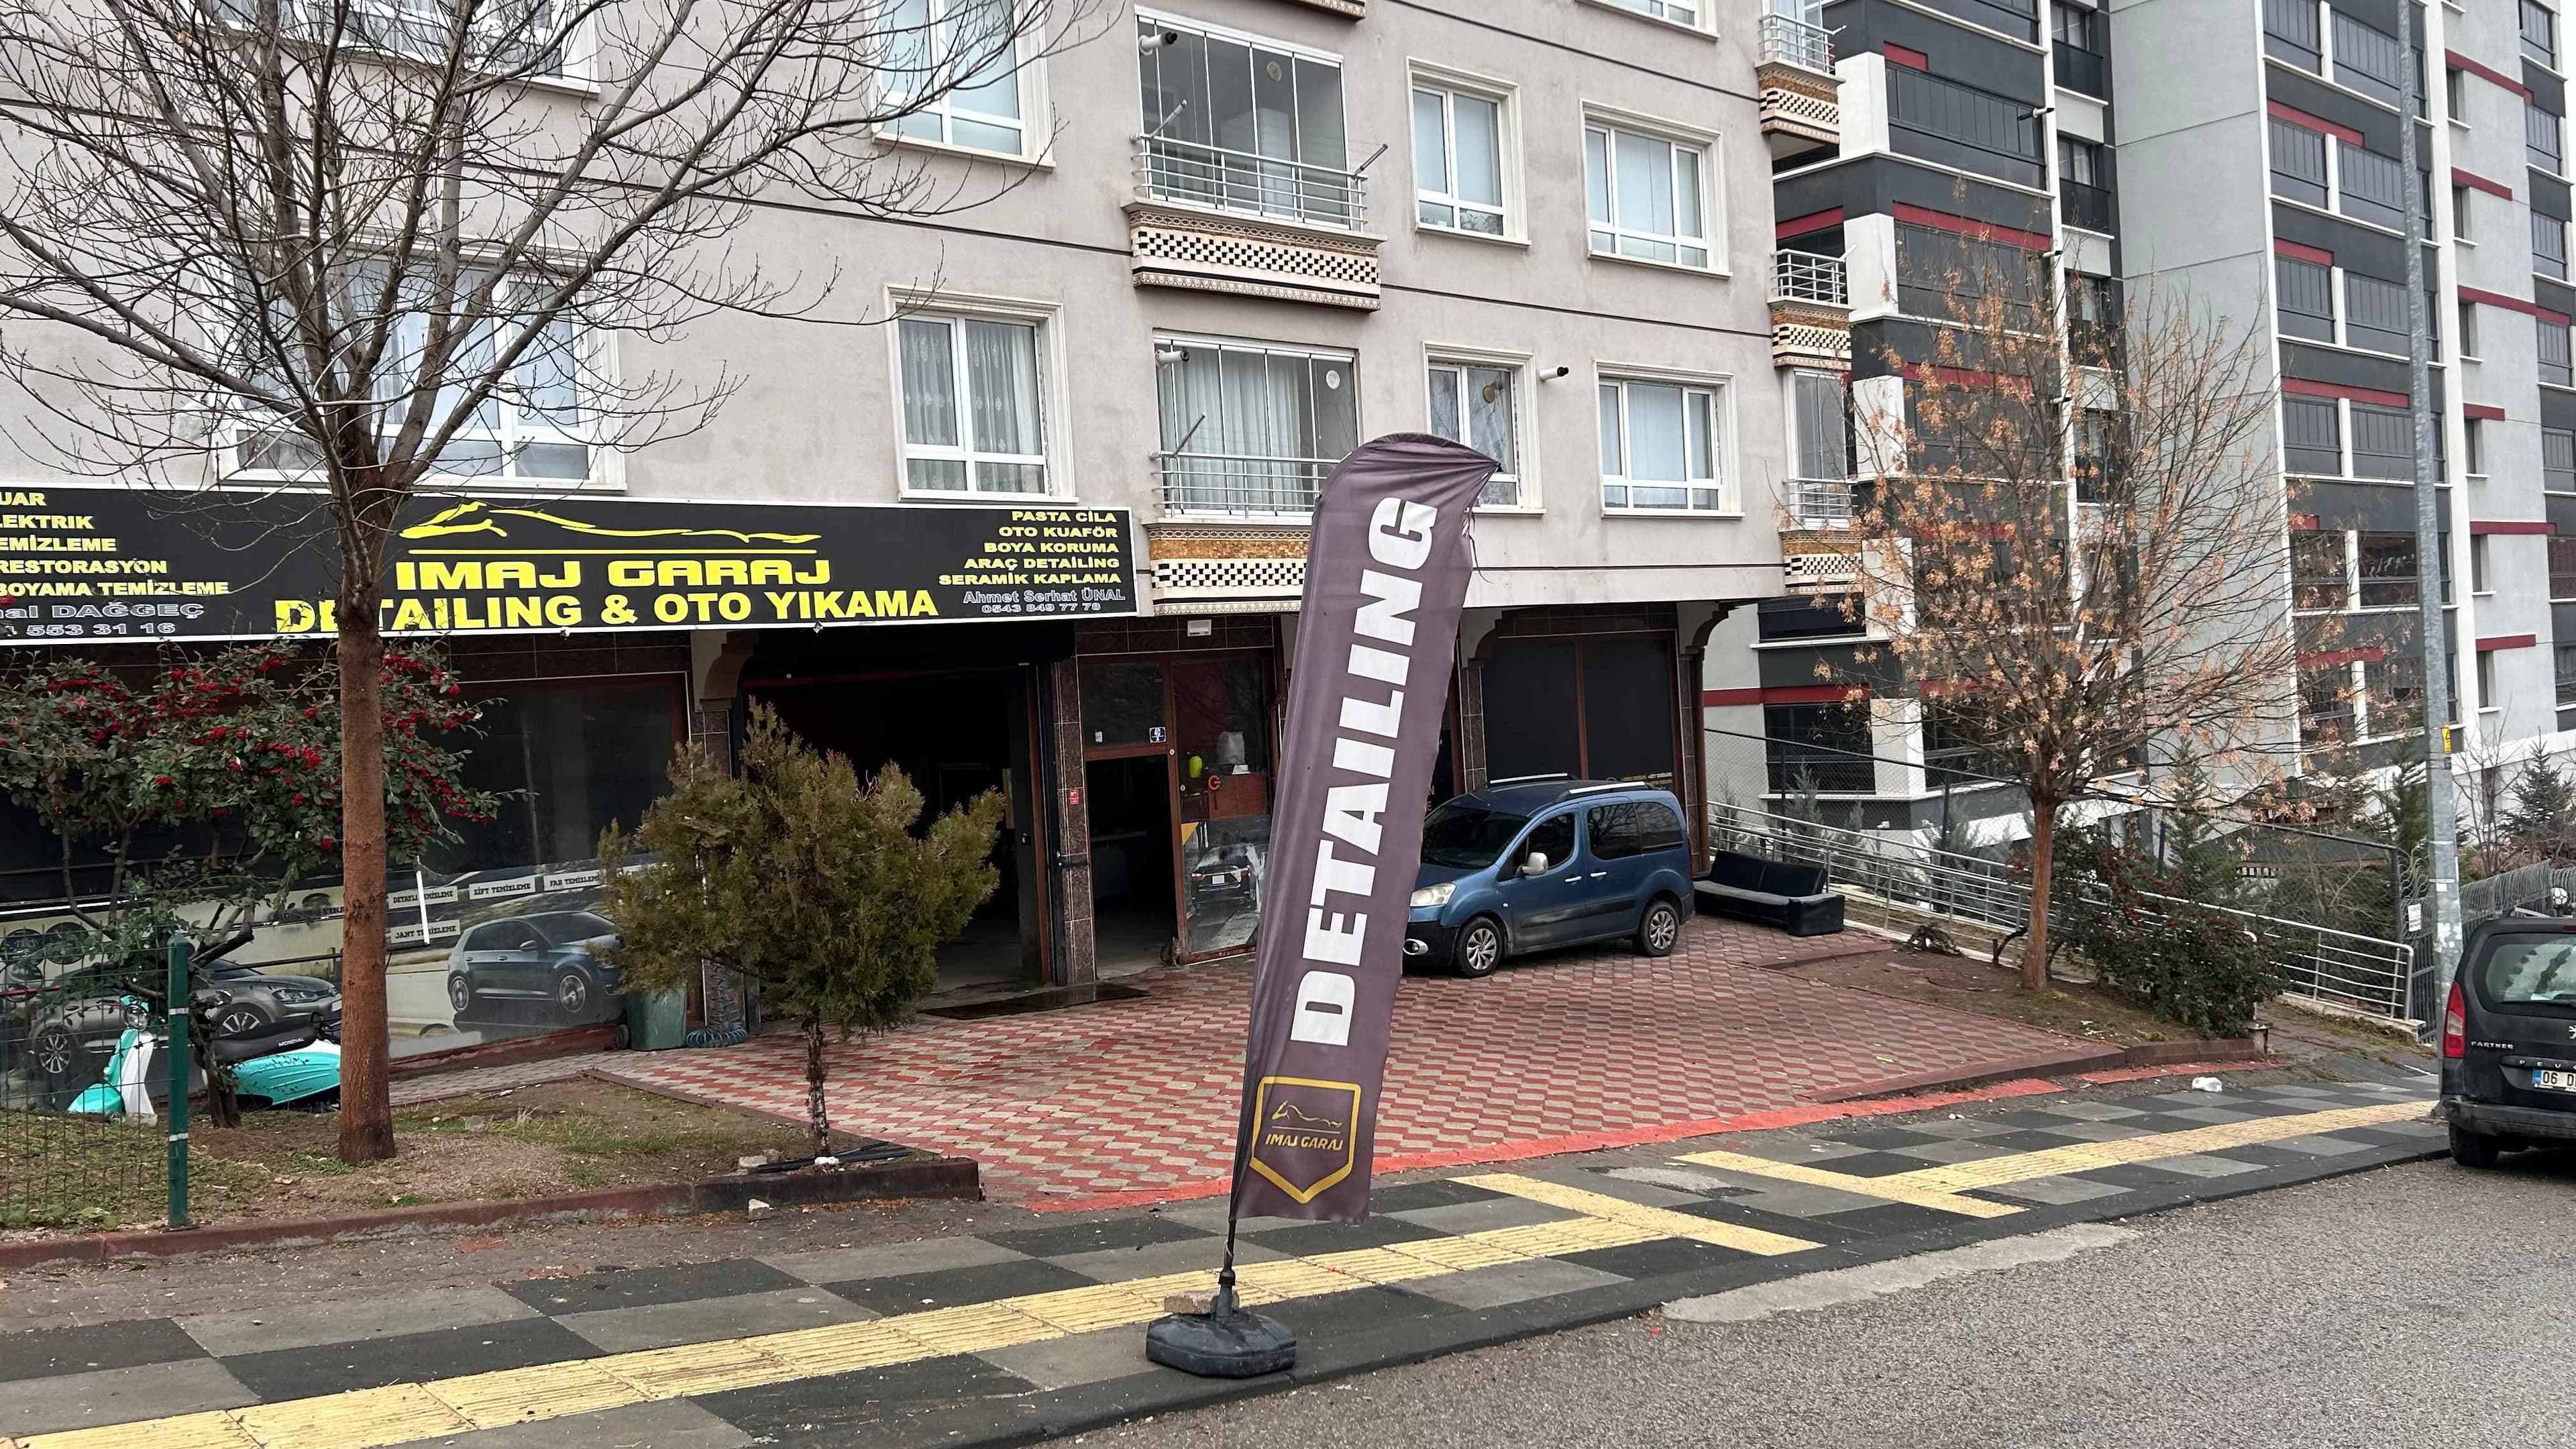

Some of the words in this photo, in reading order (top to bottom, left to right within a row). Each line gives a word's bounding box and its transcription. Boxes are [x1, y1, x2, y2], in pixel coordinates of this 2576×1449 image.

[0, 515, 95, 529] EKTRIK
[1012, 511, 1071, 522] PASTA
[1075, 511, 1118, 523] CİLA
[998, 527, 1038, 537] OTO
[1043, 526, 1118, 538] KUAFÖR
[0, 535, 117, 551] EMİZLEME
[984, 542, 1036, 553] BOYA
[1040, 543, 1120, 553] KORUMA
[0, 559, 167, 574] RESTORASYON
[963, 558, 1019, 571] ARAÇ
[1024, 556, 1120, 569] DETAİLİNG
[396, 561, 581, 590] IMAJ
[608, 559, 830, 587] GARAJ
[938, 572, 1029, 585] SERAMİK
[1034, 574, 1122, 584] KAPLAMA
[0, 582, 93, 596] BOYAMA
[97, 579, 229, 596] TEMİZLEME
[963, 590, 1019, 603] Ahmet
[1024, 590, 1077, 602] Serhat
[1081, 587, 1126, 602] ÜNAL
[0, 605, 38, 619] al
[52, 602, 204, 619] DAĞGEÇ
[274, 595, 582, 633] DAILING
[601, 594, 638, 625] &
[654, 592, 751, 623] OTO
[764, 590, 938, 619] YIKAMA
[981, 604, 1022, 613] 0543
[1026, 604, 1055, 612] 849
[1059, 603, 1078, 611] 77
[26, 625, 83, 636] 553
[93, 623, 127, 635] 31
[140, 623, 176, 633] 16
[1291, 497, 1438, 1046] DETAILING
[564, 874, 600, 885] TEMİZLEM
[422, 891, 453, 900] EMİZLEME
[395, 931, 415, 939] JANT
[278, 1037, 305, 1046] MONDIAL
[2471, 1041, 2514, 1050] PARTNER
[2543, 1071, 2558, 1084] 06
[1265, 1134, 1298, 1146] IMAJ
[1301, 1136, 1343, 1151] GARAJ
